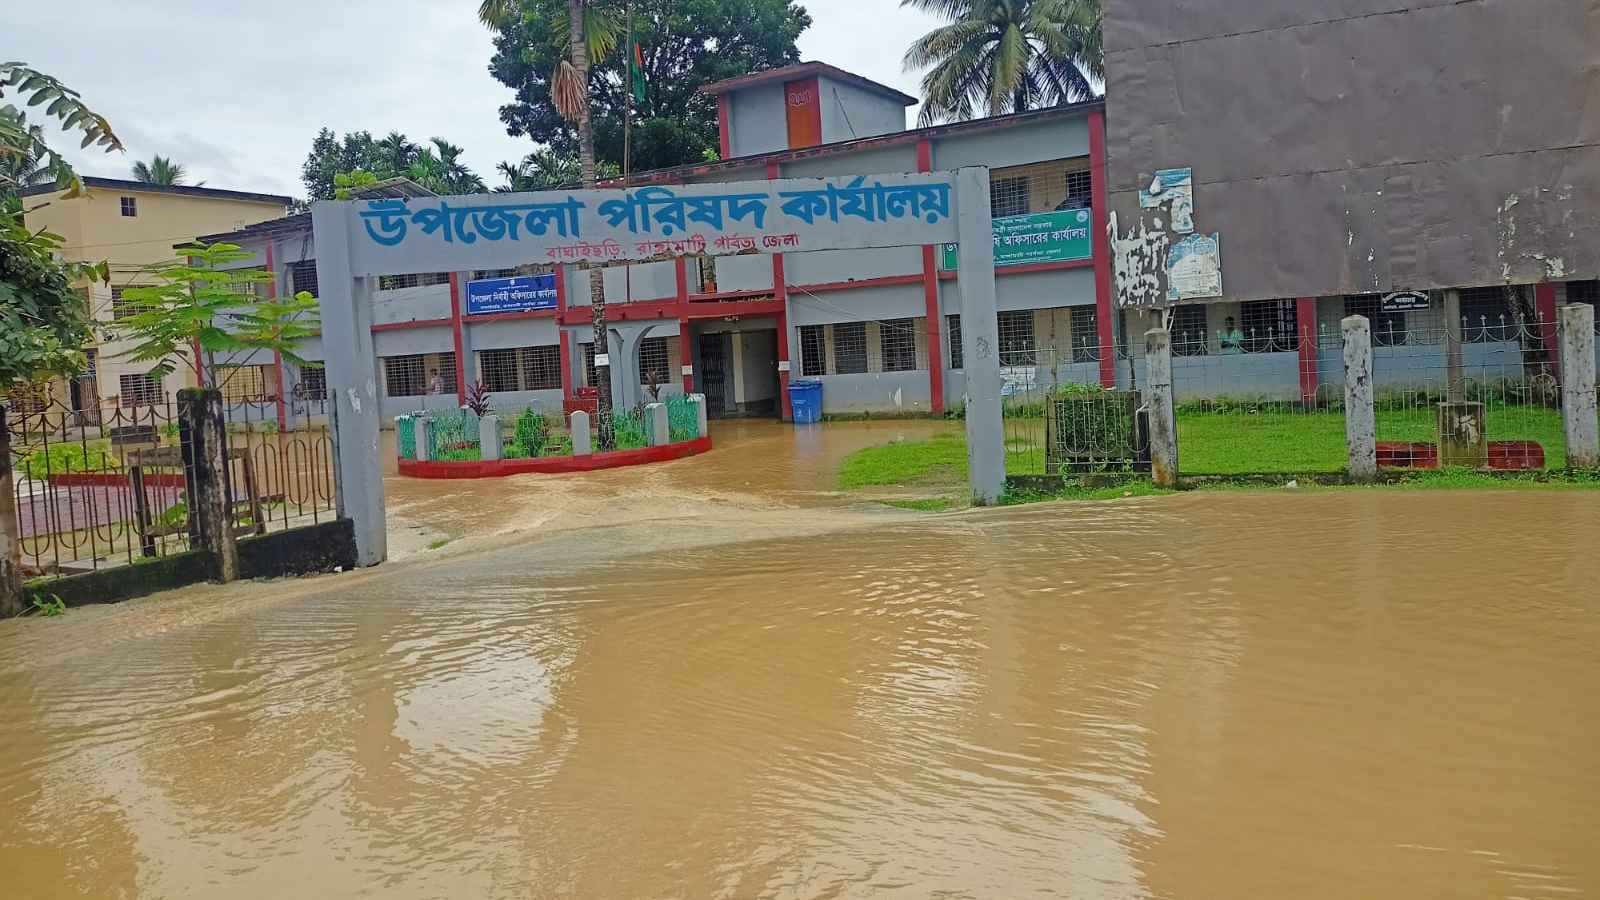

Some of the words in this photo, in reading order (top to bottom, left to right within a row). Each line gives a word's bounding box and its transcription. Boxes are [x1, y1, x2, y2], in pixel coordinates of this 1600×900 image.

[360, 195, 586, 246] উপজেলা
[597, 186, 770, 237] পরিষদ
[778, 175, 953, 225] কার্যালয়
[763, 233, 800, 248] জেলা
[1004, 231, 1048, 247] অফিসারের
[1052, 225, 1088, 241] কার্যালয়
